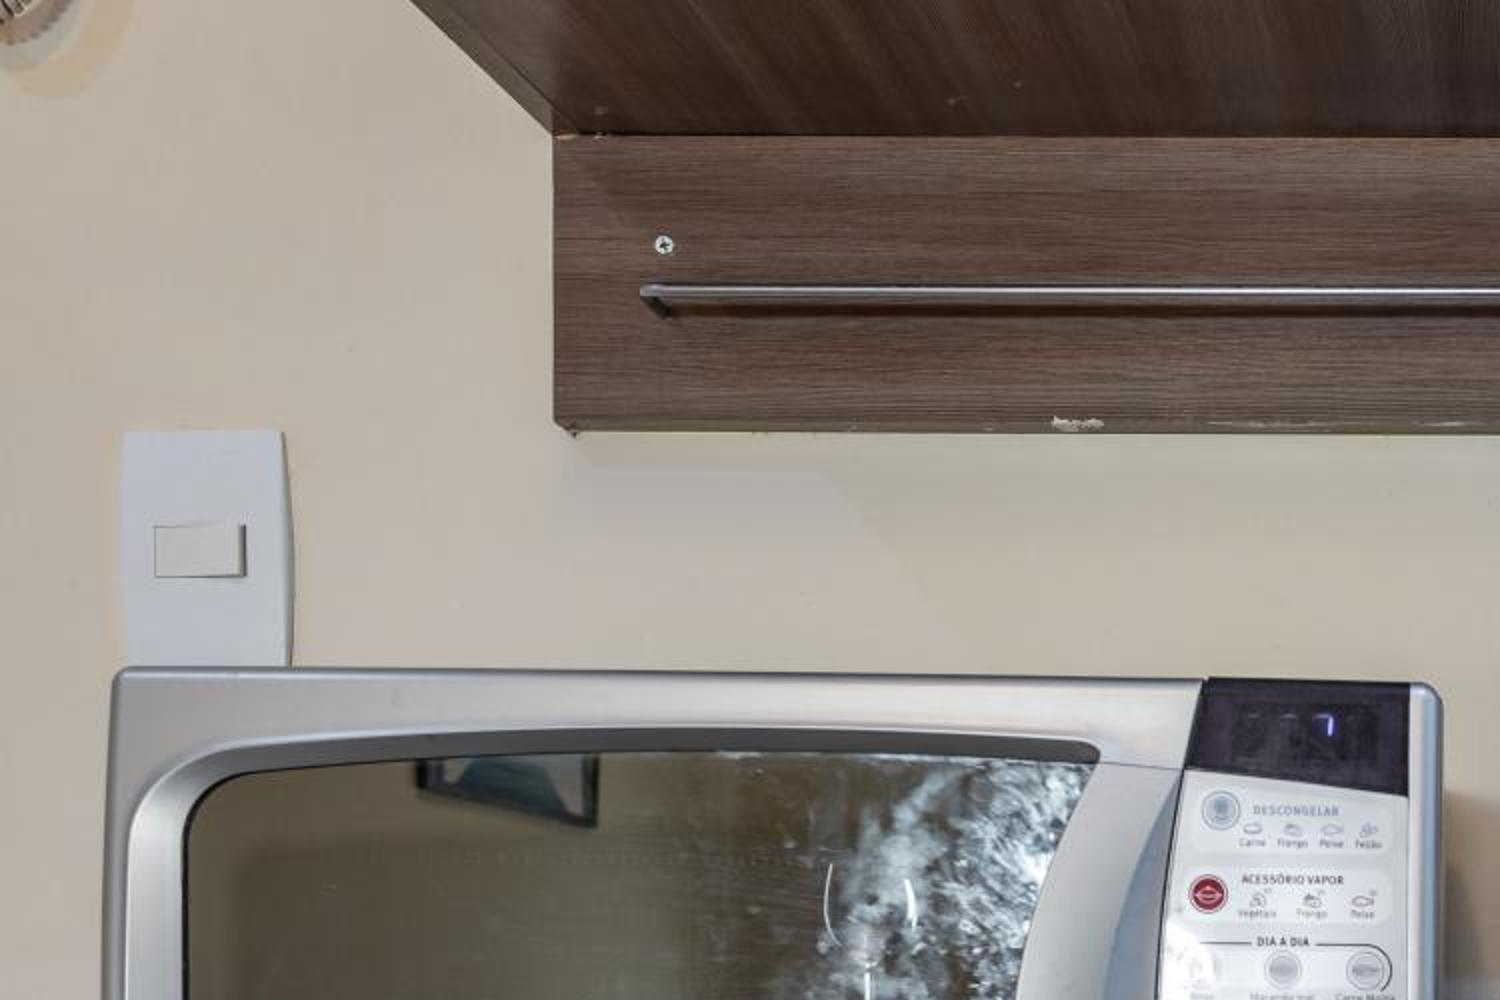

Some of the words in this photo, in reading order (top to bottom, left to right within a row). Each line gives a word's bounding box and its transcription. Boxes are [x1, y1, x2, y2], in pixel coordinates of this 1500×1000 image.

[1252, 804, 1340, 817] DESCONGELAR
[1241, 873, 1305, 885] ACESSÓRIO
[1307, 875, 1345, 886] VAPOR
[1257, 936, 1276, 947] DIA
[1279, 937, 1288, 947] A
[1289, 937, 1310, 947] DIA
